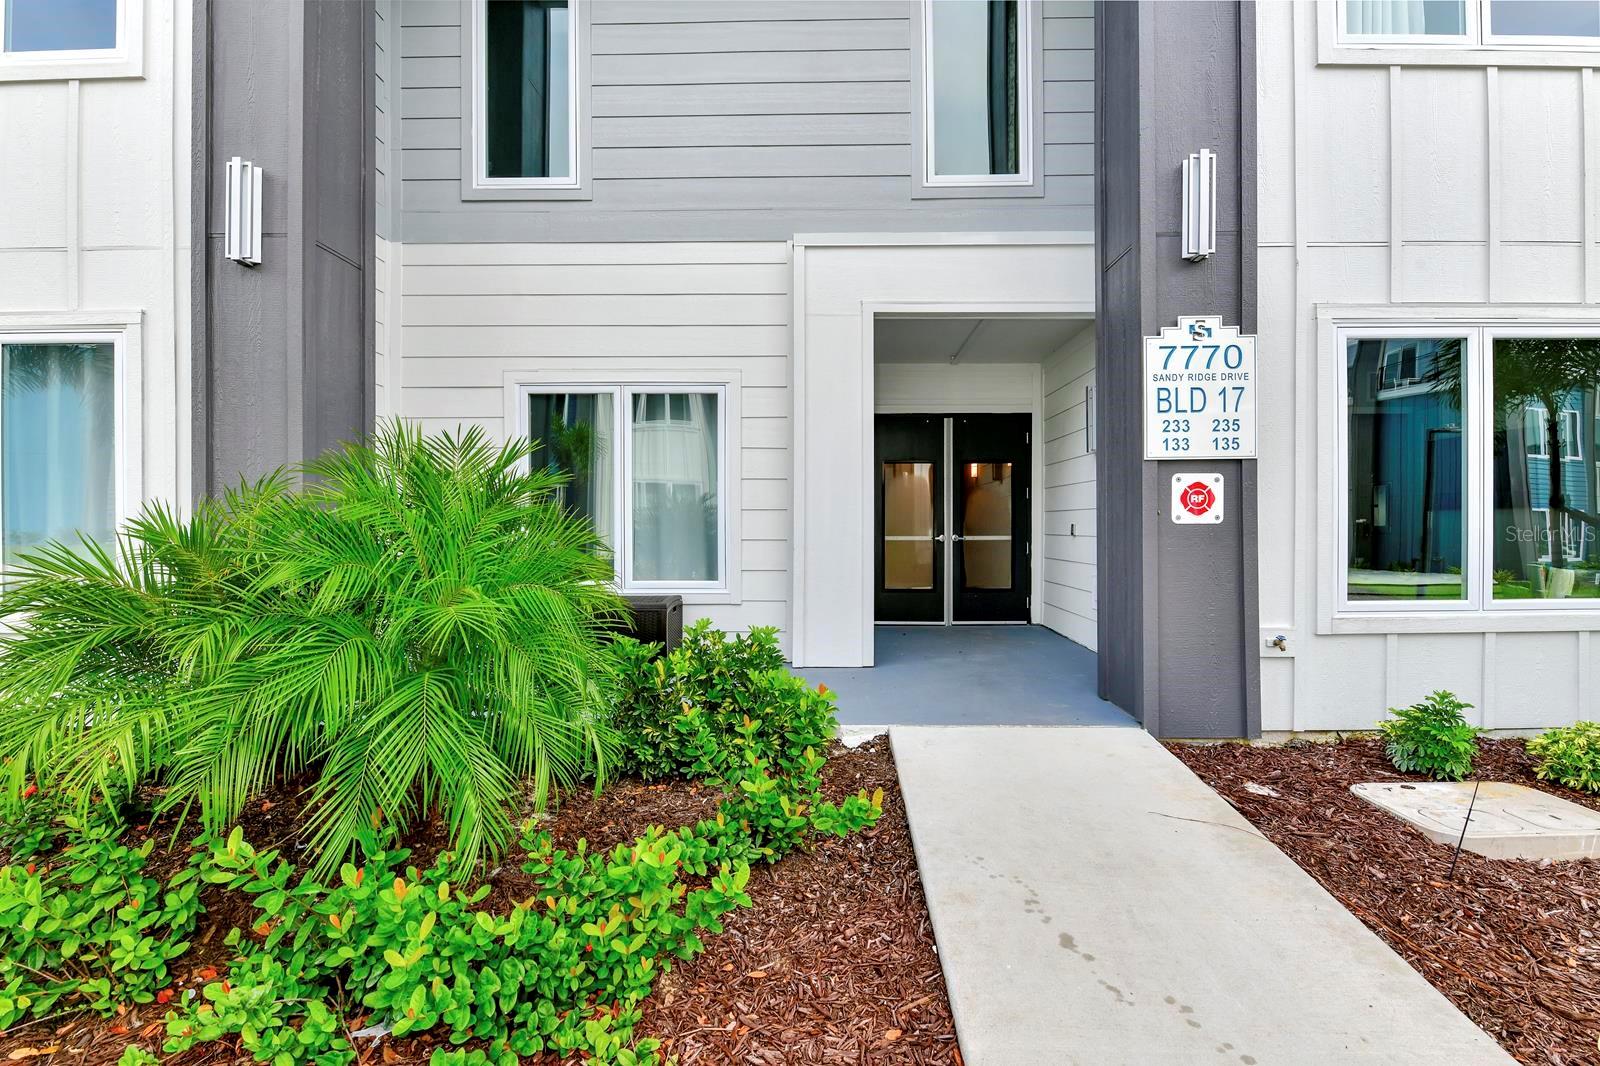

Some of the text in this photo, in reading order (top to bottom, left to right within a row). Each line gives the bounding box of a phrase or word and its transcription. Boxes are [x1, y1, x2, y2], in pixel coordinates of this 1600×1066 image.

[1158, 344, 1243, 370] 7770
[1152, 372, 1249, 382] SANDY RIDGE DRIVE
[1157, 386, 1245, 414] BLD 17
[1162, 418, 1240, 433] 233 235
[1162, 437, 1240, 451] 133 135
[1190, 494, 1205, 503] RF
